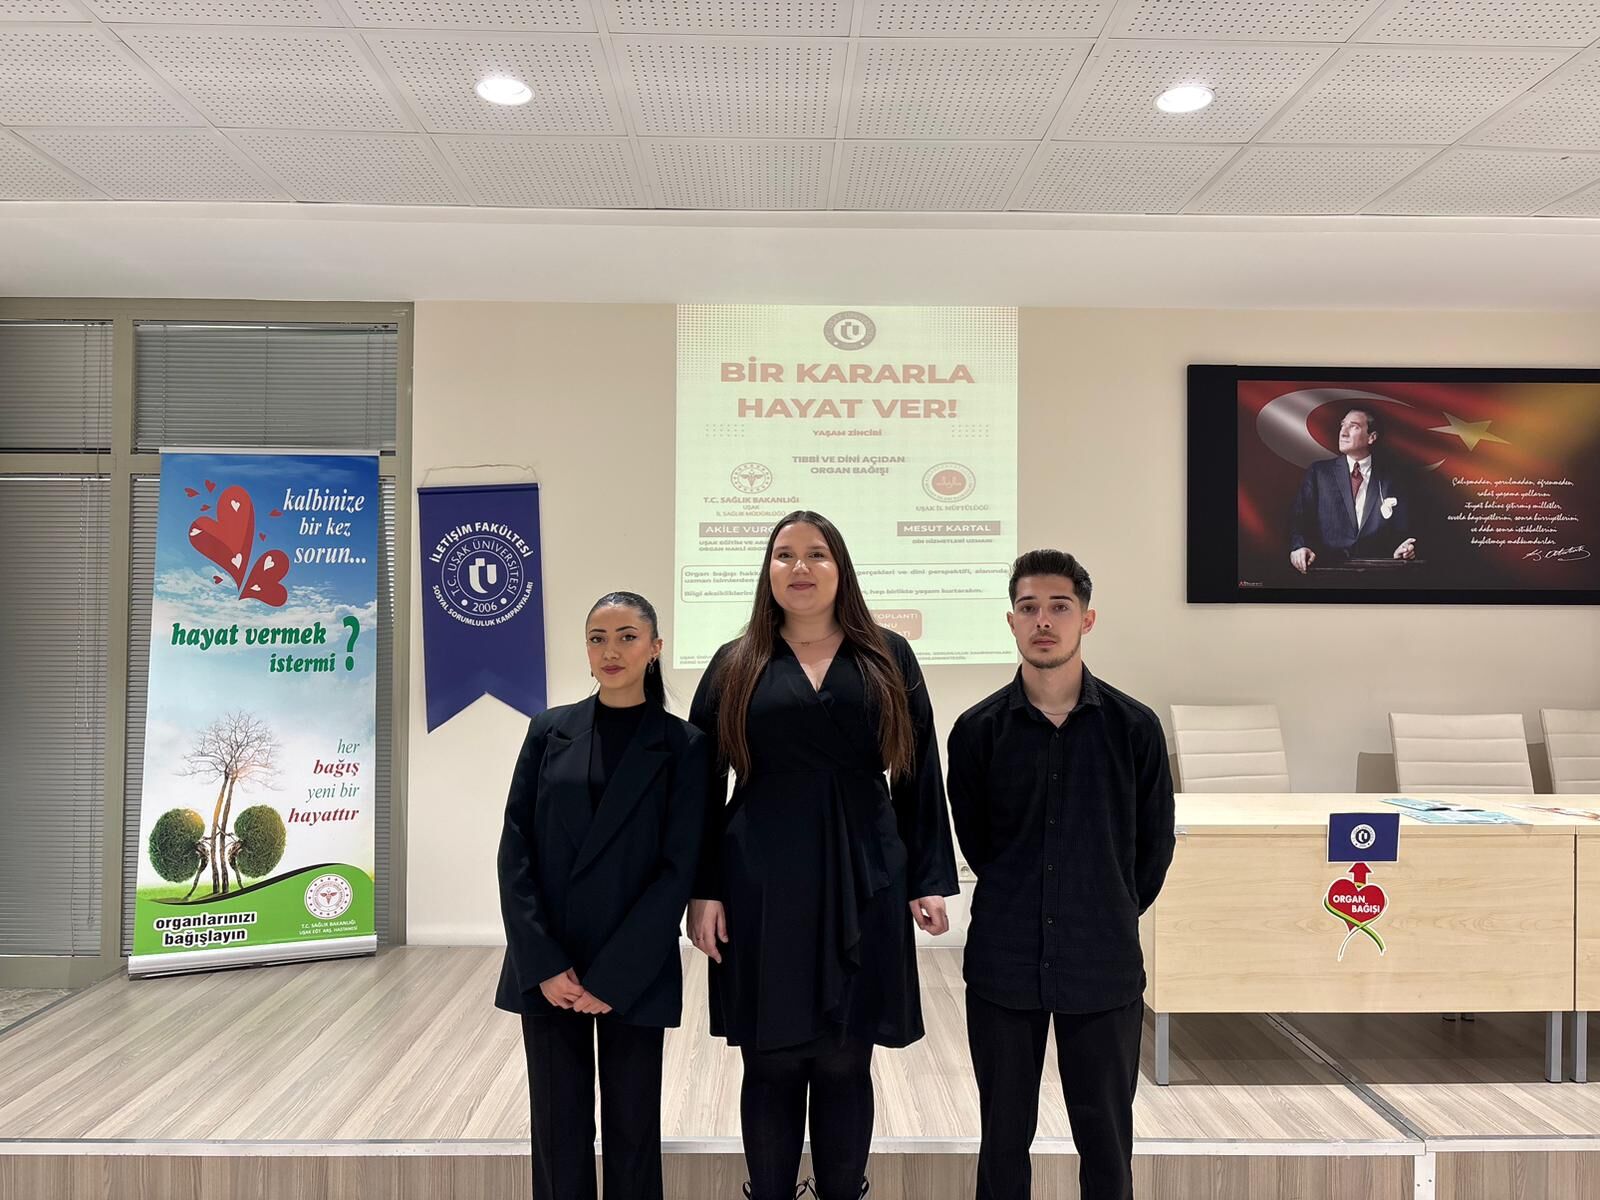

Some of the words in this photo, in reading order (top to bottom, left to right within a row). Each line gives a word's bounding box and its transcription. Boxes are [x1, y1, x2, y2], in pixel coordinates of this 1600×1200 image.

[720, 356, 784, 383] BİR
[796, 364, 975, 384] KARARLA
[738, 398, 863, 418] HAYAT
[870, 399, 957, 418] VER!
[812, 429, 846, 437] YAŞAM
[792, 455, 820, 464] TIBBİ
[837, 454, 860, 464] DİNİ
[862, 456, 905, 465] AÇIDAN
[810, 466, 848, 475] ORGAN
[850, 465, 889, 476] BAĞIŞI
[283, 488, 365, 514] kalbinize
[720, 496, 751, 504] SAĞLIK
[299, 517, 322, 536] bir
[326, 518, 351, 537] kez
[705, 525, 740, 533] AKİLE
[428, 523, 473, 563] İLETİŞİM
[474, 522, 534, 558] FAKÜLTESİ
[294, 546, 367, 564] sorun...
[432, 584, 449, 611] SOSYAL
[447, 608, 496, 627] SORUMLULUK
[495, 581, 534, 624] KAMPANYALARI
[472, 602, 498, 613] 2006
[171, 622, 239, 651] hayat
[244, 621, 327, 645] vermek
[270, 652, 336, 673] istermi
[336, 738, 360, 754] her
[313, 759, 360, 778] bağış
[306, 783, 337, 803] yeni
[339, 783, 360, 798] bir
[287, 807, 359, 827] hayattır
[1332, 894, 1366, 904] ORGAN
[1351, 903, 1381, 914] BAĞIŞI
[155, 912, 256, 933] organlarınızı
[163, 928, 246, 946] bağışlayın
